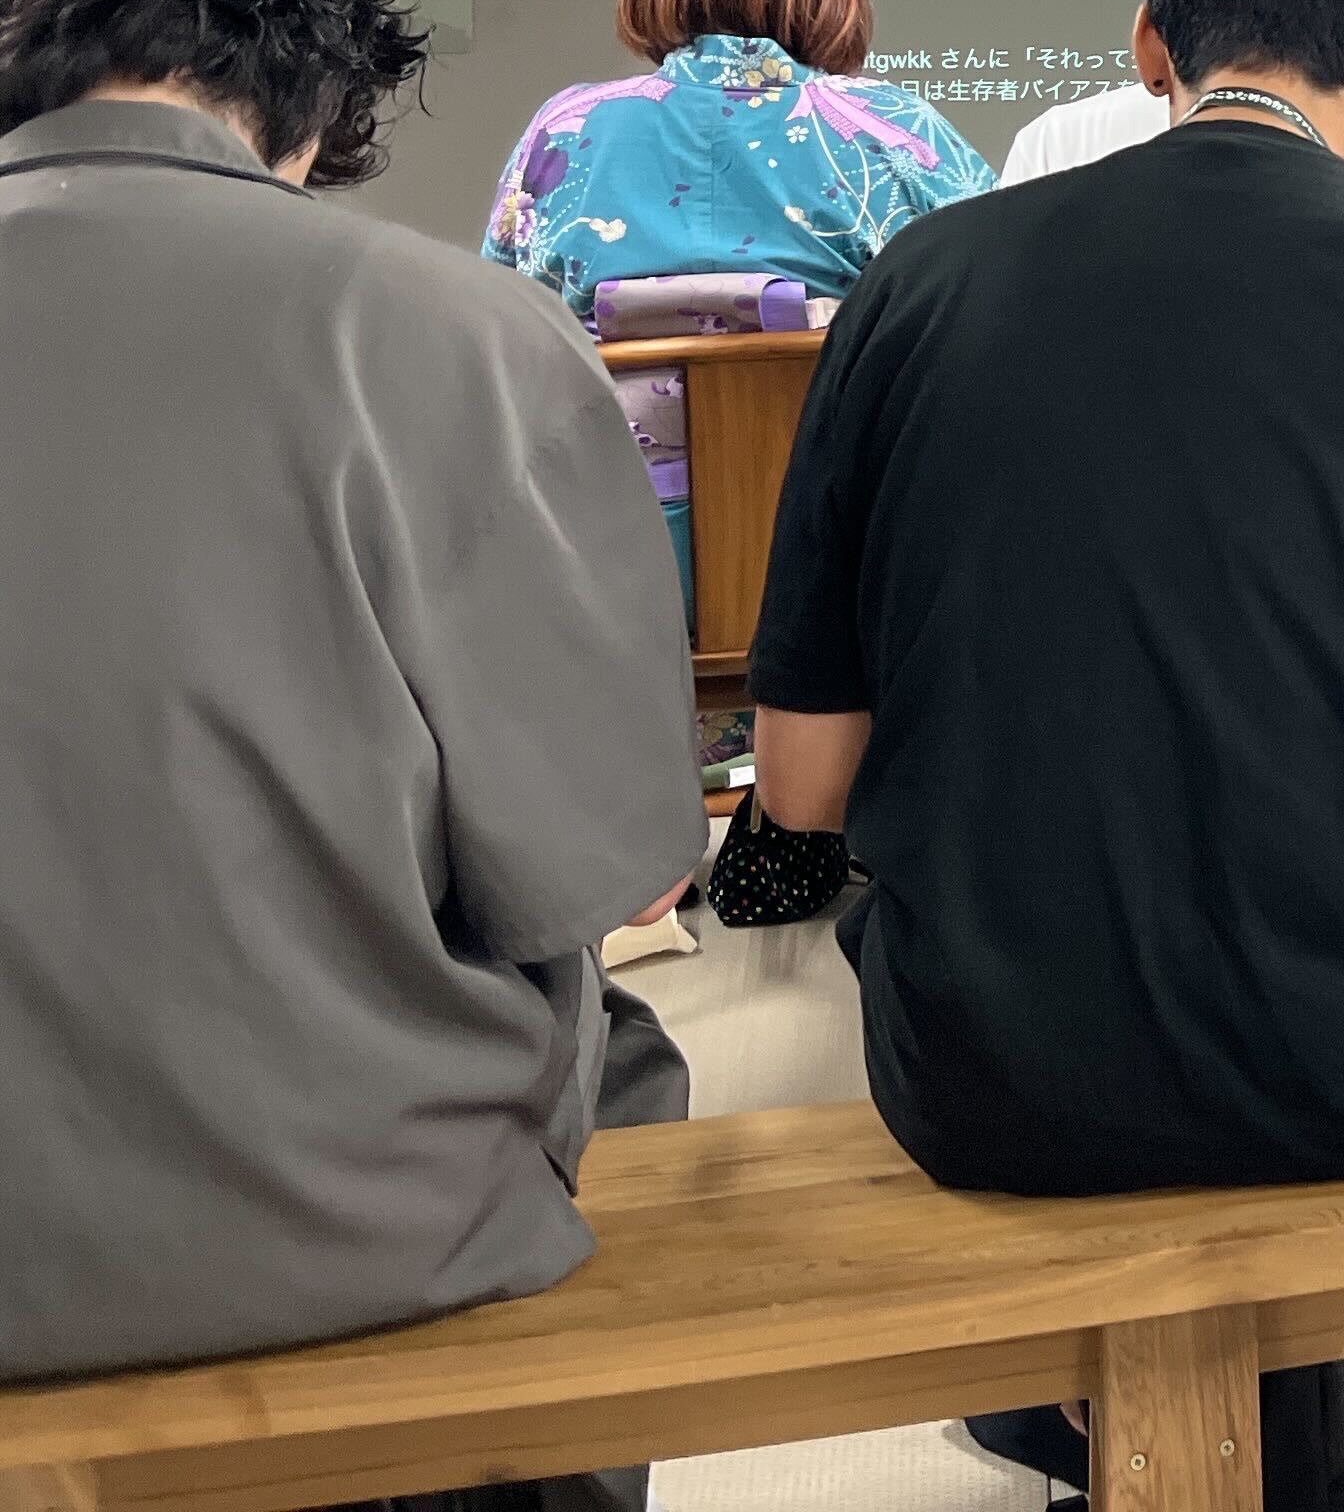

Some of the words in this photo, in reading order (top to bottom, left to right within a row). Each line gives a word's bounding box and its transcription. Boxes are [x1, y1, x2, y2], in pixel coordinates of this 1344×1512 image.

[941, 47, 1137, 70] さんに「それって
